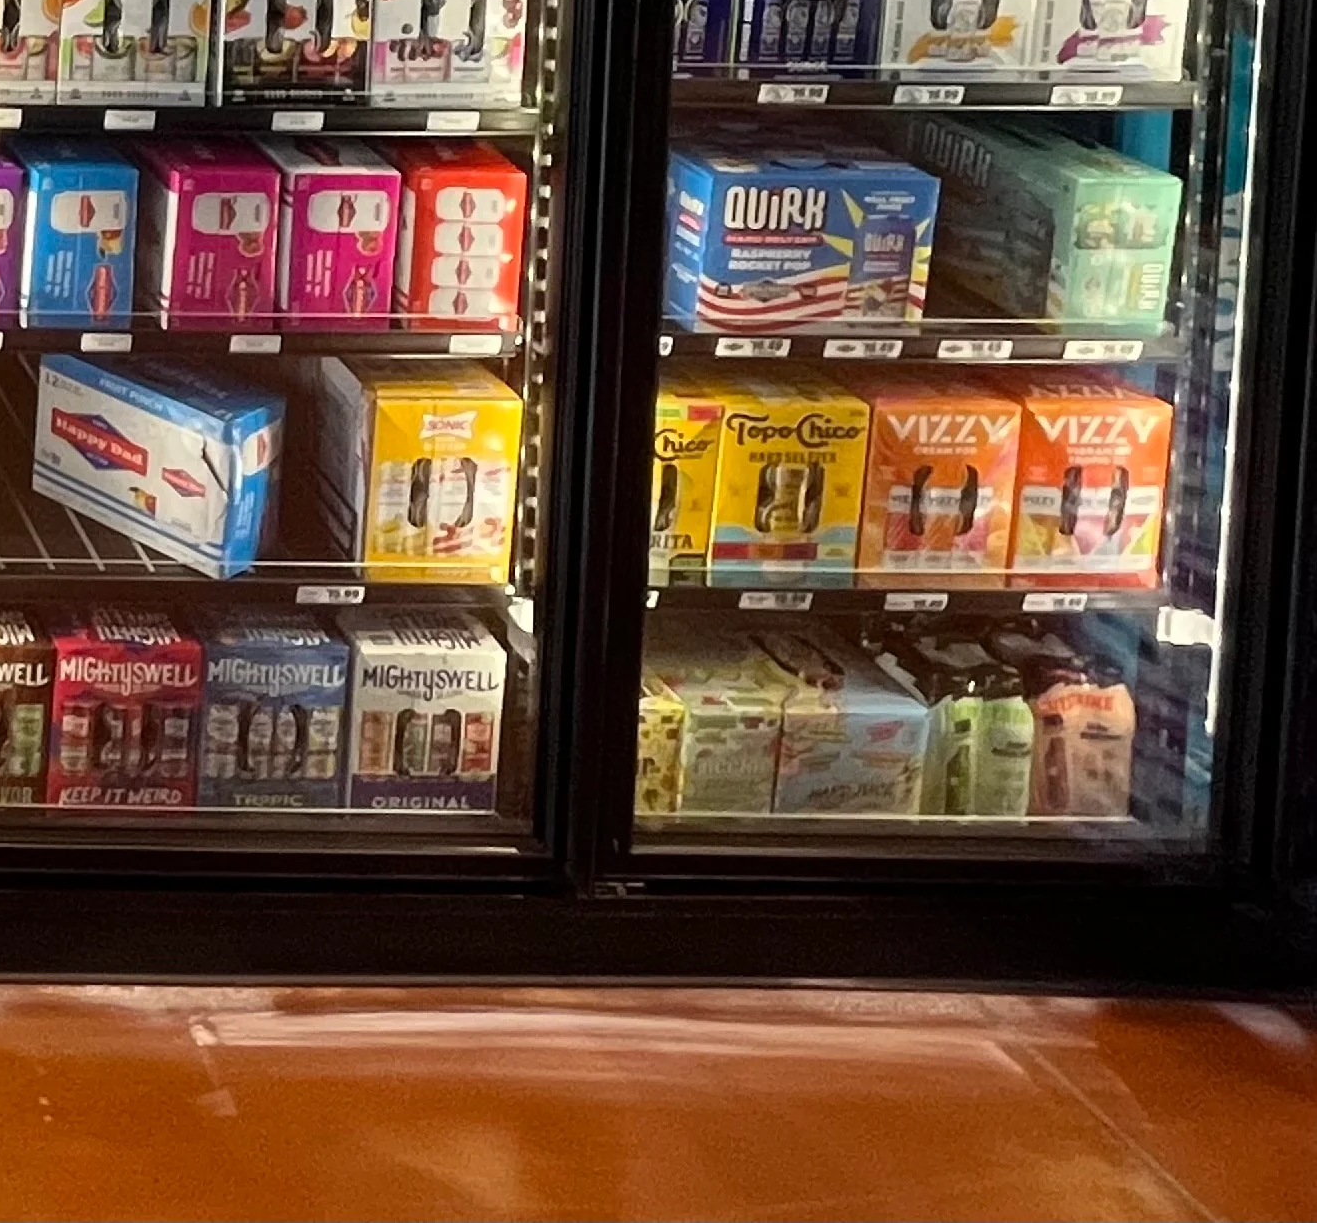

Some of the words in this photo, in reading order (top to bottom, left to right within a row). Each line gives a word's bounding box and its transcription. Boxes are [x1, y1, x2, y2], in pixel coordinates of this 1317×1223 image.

[784, 261, 811, 270] POP
[426, 417, 470, 433] SONIC
[727, 412, 793, 446] Topo
[795, 413, 864, 448] Chico
[887, 415, 1014, 445] VIZZY
[1035, 416, 1159, 444] VIZZY
[55, 416, 108, 450] Happy
[109, 441, 143, 466] Dad
[58, 788, 104, 805] KEEP
[108, 788, 124, 804] IT
[127, 788, 182, 805] WEIRD
[372, 795, 470, 810] ORIGINAL
